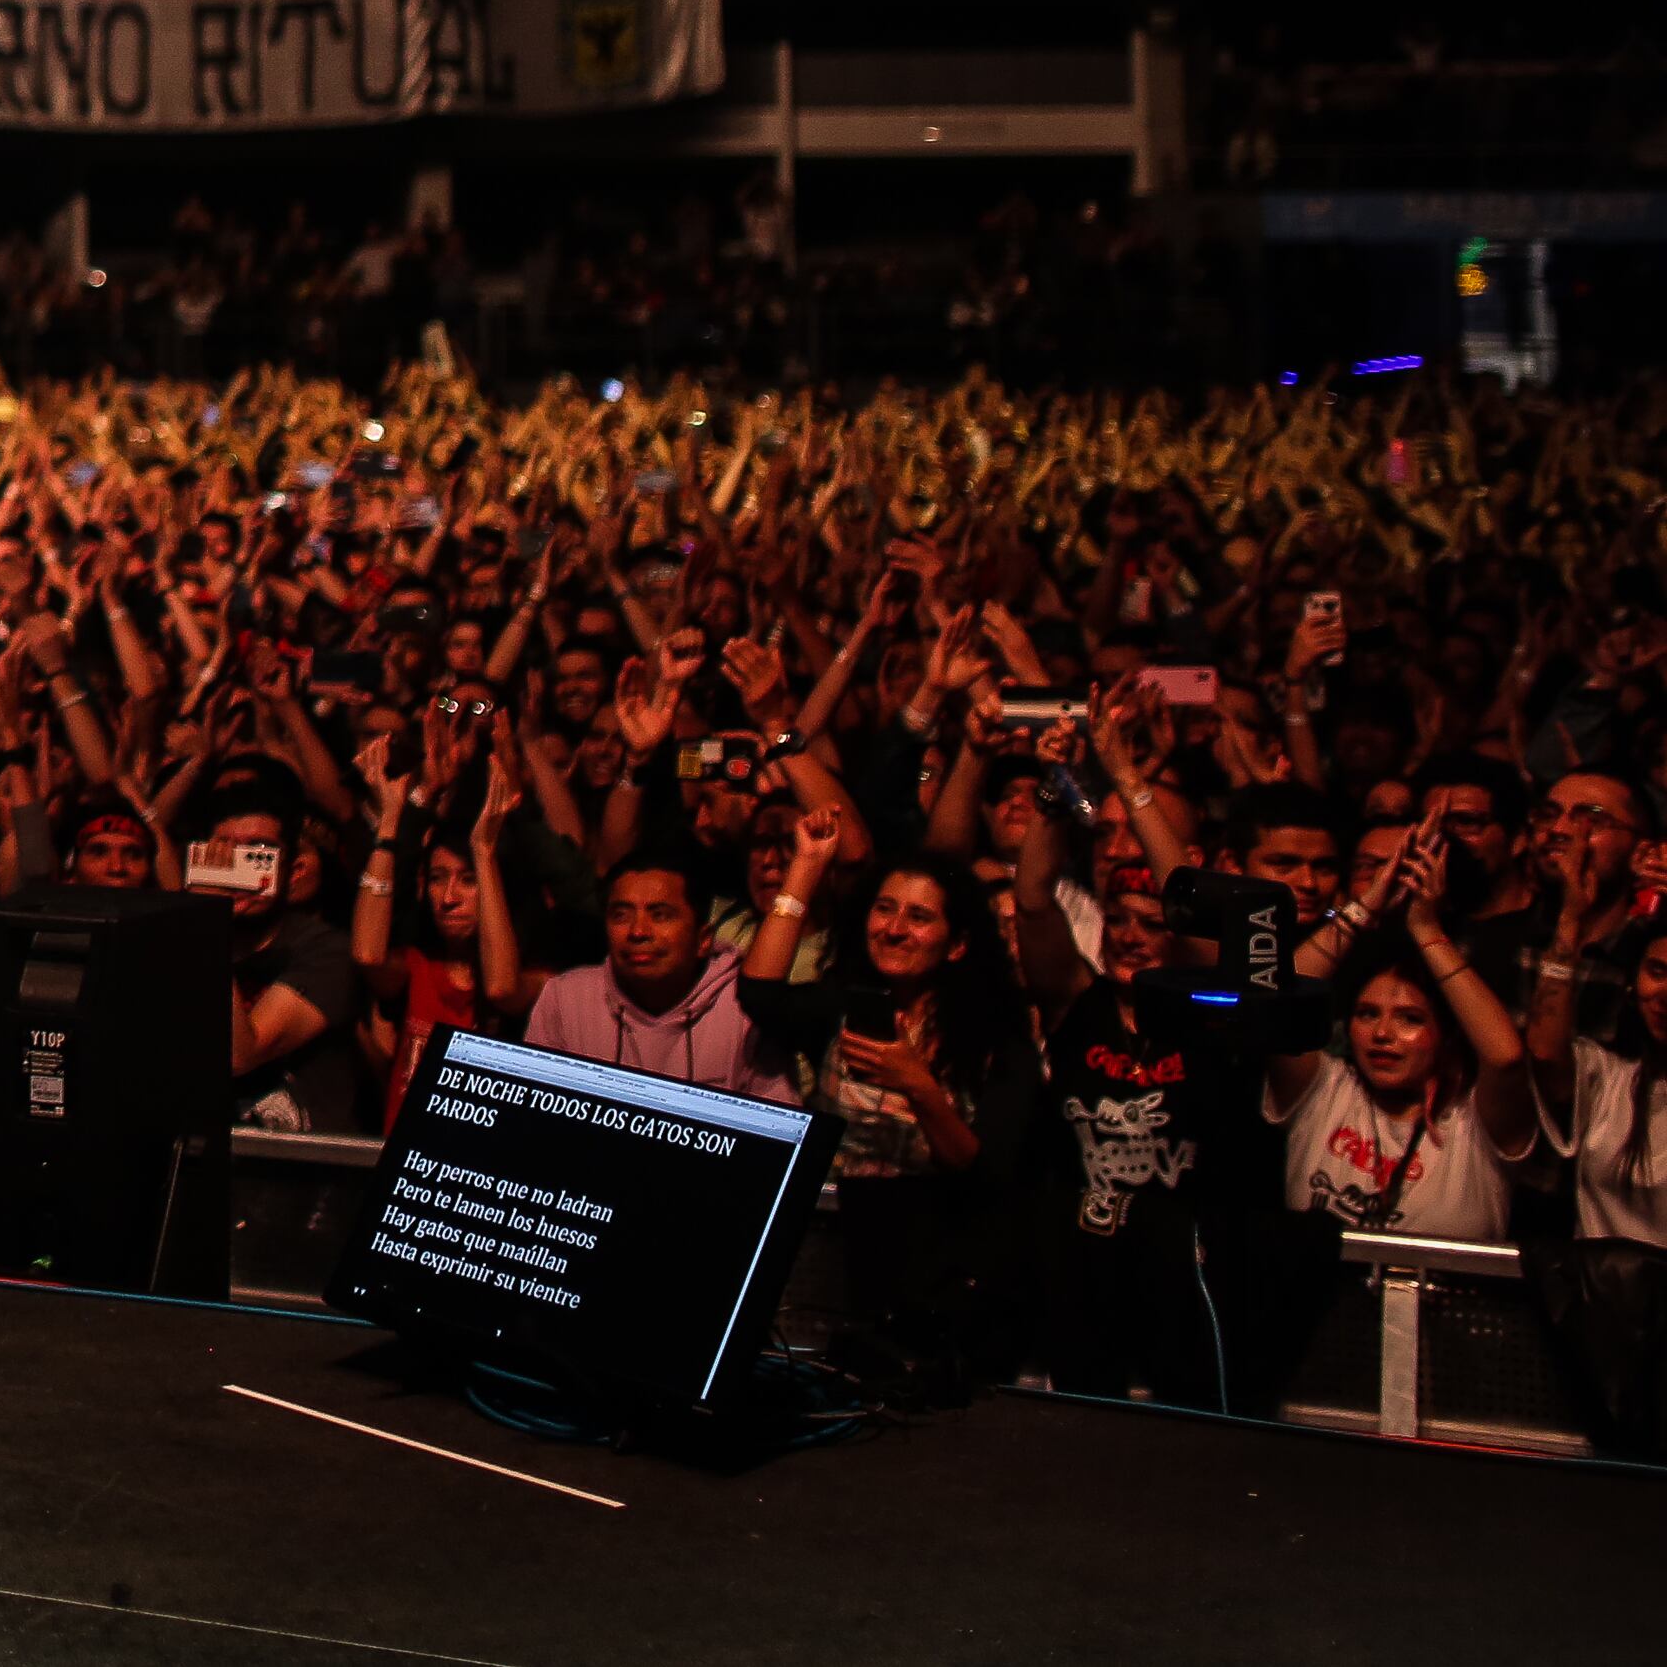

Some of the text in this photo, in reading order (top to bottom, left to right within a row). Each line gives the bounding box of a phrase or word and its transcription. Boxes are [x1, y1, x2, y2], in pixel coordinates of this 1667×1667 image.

[1248, 904, 1278, 990] AIDA
[426, 1093, 499, 1128] PARDOS
[436, 1066, 737, 1157] DE NOCHE TODOS LOS GATOS SON
[392, 1176, 598, 1250] Pero te lamen los huesos
[403, 1149, 613, 1223] Hay perros que no ladran
[370, 1231, 581, 1309] Hasta exprimir su vientre
[381, 1204, 568, 1274] Hay gatos que maúllan
